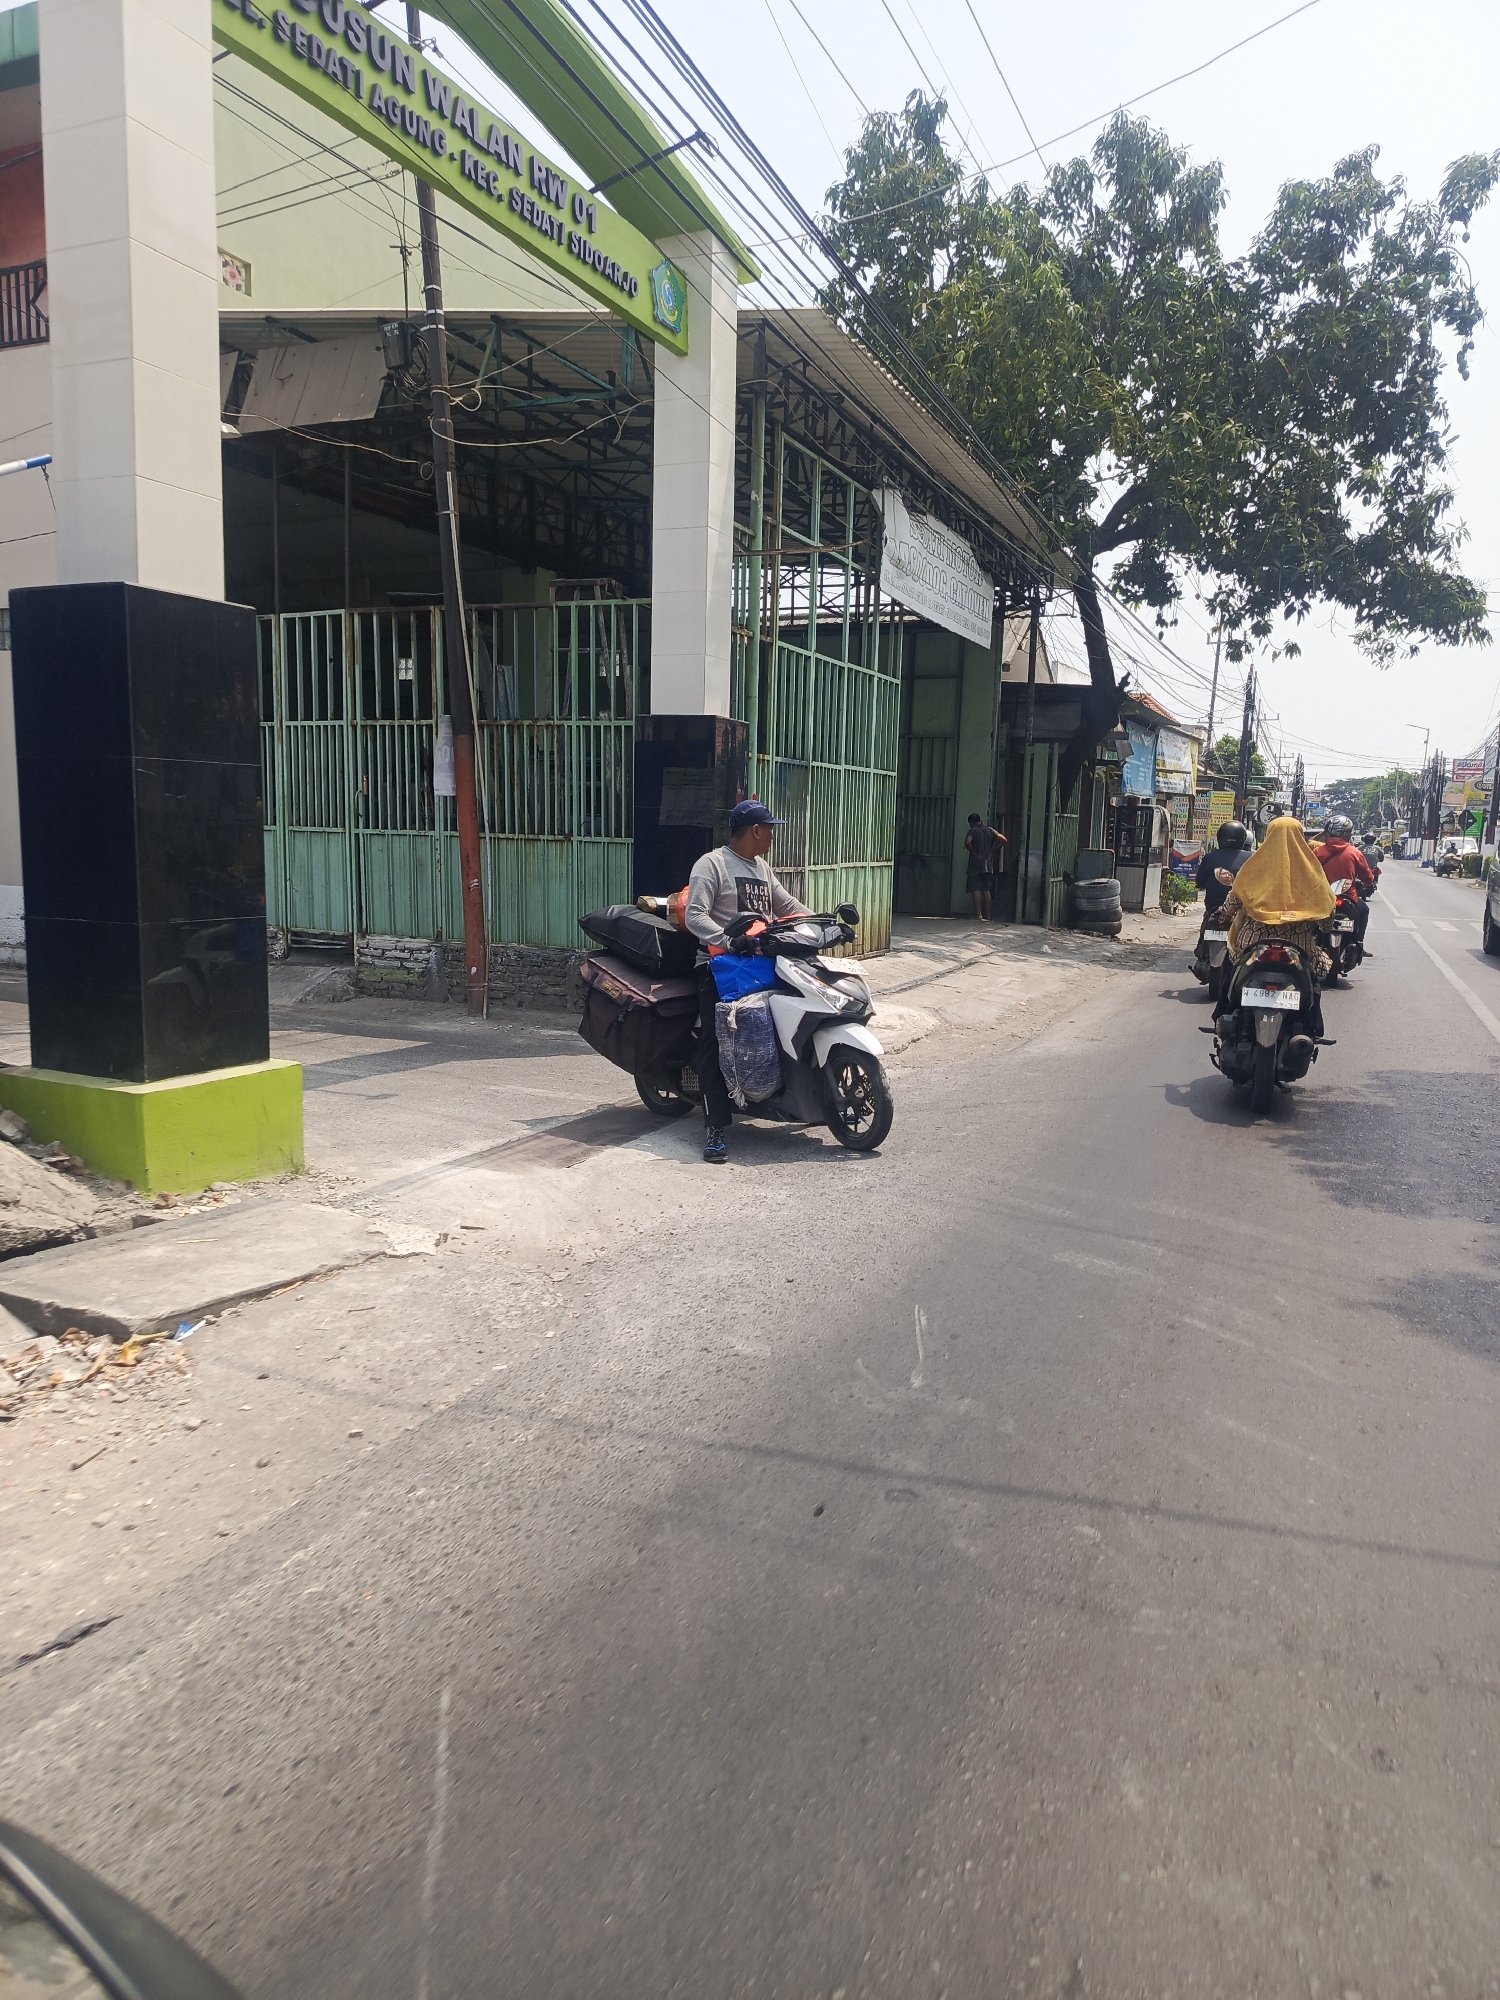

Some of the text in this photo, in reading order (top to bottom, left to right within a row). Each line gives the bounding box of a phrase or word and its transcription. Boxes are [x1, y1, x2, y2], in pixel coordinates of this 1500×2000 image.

[290, 0, 598, 234] USUN WALAN RW 01
[273, 9, 364, 99] SEDATI
[370, 84, 447, 156] AGUNG
[462, 149, 505, 202] KEC.
[509, 187, 566, 246] SEDATI
[569, 230, 640, 299] SIDOARJO
[745, 883, 768, 896] BLACK
[746, 898, 769, 911] 1921
[1282, 991, 1299, 1001] NAG
